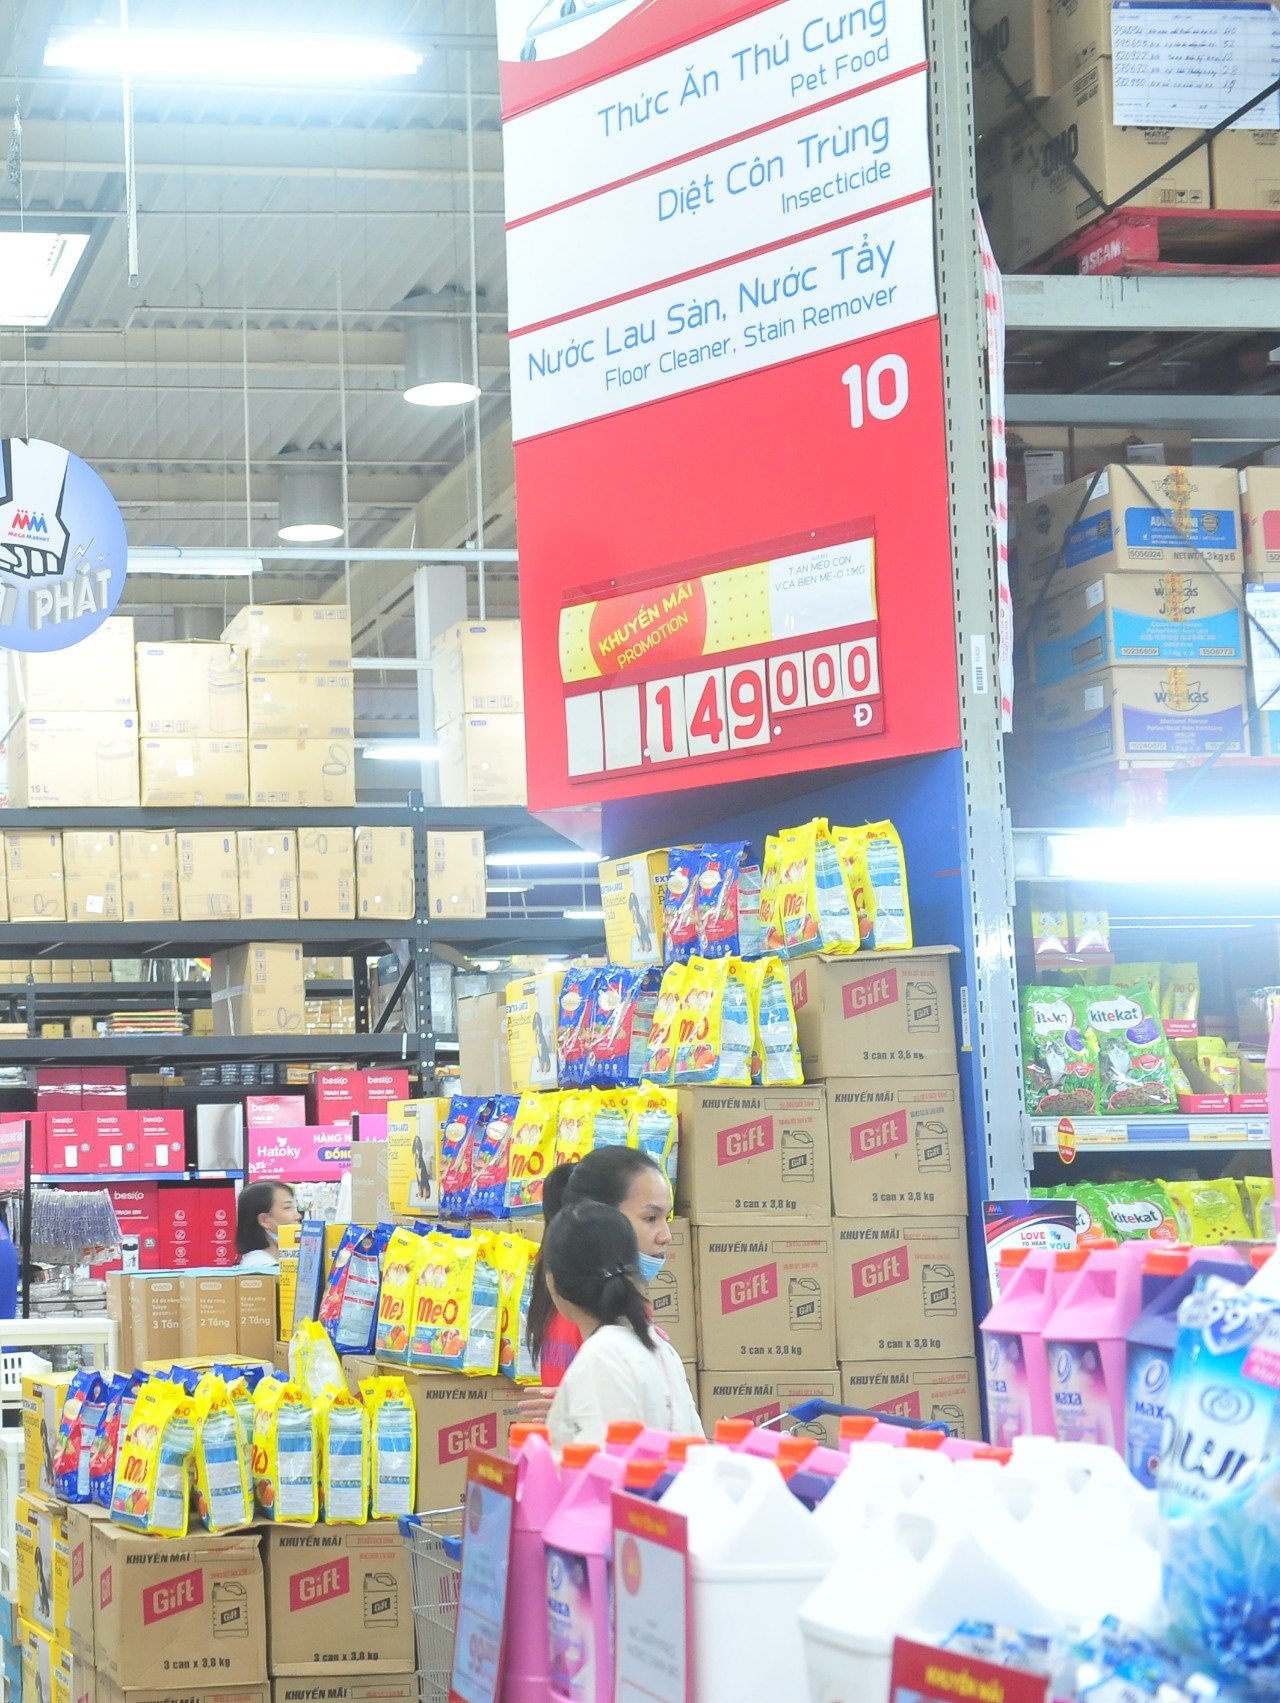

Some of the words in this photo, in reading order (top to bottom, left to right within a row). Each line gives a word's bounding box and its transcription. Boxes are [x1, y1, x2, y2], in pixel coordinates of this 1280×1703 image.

[597, 91, 669, 137] Thức
[679, 65, 719, 106] Ăn
[731, 34, 791, 82] Thú
[802, 0, 887, 52] Cưng
[790, 66, 826, 98] Pet
[835, 39, 890, 75] Food
[658, 173, 714, 221] Diệt
[726, 152, 784, 195] Côn
[797, 116, 890, 168] Trùng
[782, 160, 891, 214] Insecticide
[528, 336, 595, 380] Nước
[605, 316, 655, 356] Lau
[739, 265, 818, 314] Nước
[831, 232, 895, 281] Tẩy
[605, 362, 651, 391] Floor
[659, 336, 737, 374] Cleaner,
[743, 315, 795, 349] Stain
[804, 284, 898, 326] Remover
[841, 353, 909, 429] 10
[29, 561, 112, 631] PHÁT
[597, 600, 660, 657] KHUYẾN
[616, 610, 689, 670] PROMOTION
[1154, 691, 1209, 703] wkas
[851, 978, 890, 1010] Gift
[1089, 1006, 1138, 1024] kitekat
[702, 1096, 740, 1110] KHUYẾN
[834, 1089, 872, 1103] KHUYẾN
[257, 1144, 301, 1159] Hatoky
[726, 1124, 766, 1157] Gift
[859, 1119, 899, 1152] Gift
[872, 1193, 878, 1202] 3
[880, 1193, 896, 1202] can
[907, 1192, 921, 1203] 3,8
[923, 1192, 935, 1203] kg
[840, 1226, 878, 1241] KHUYẾN
[1111, 1210, 1158, 1225] kitekat
[1020, 1231, 1045, 1240] LOVE
[861, 1254, 901, 1288] Gift
[730, 1272, 770, 1305] Gift
[426, 1386, 466, 1400] KHUYẾN
[448, 1421, 489, 1455] Gift
[279, 1533, 320, 1548] KHUYẾN
[152, 1579, 195, 1614] Gift
[299, 1567, 341, 1602] Gift
[164, 1660, 170, 1669] 3
[173, 1660, 190, 1669] can
[202, 1658, 216, 1669] 3,8
[219, 1658, 230, 1670] kg
